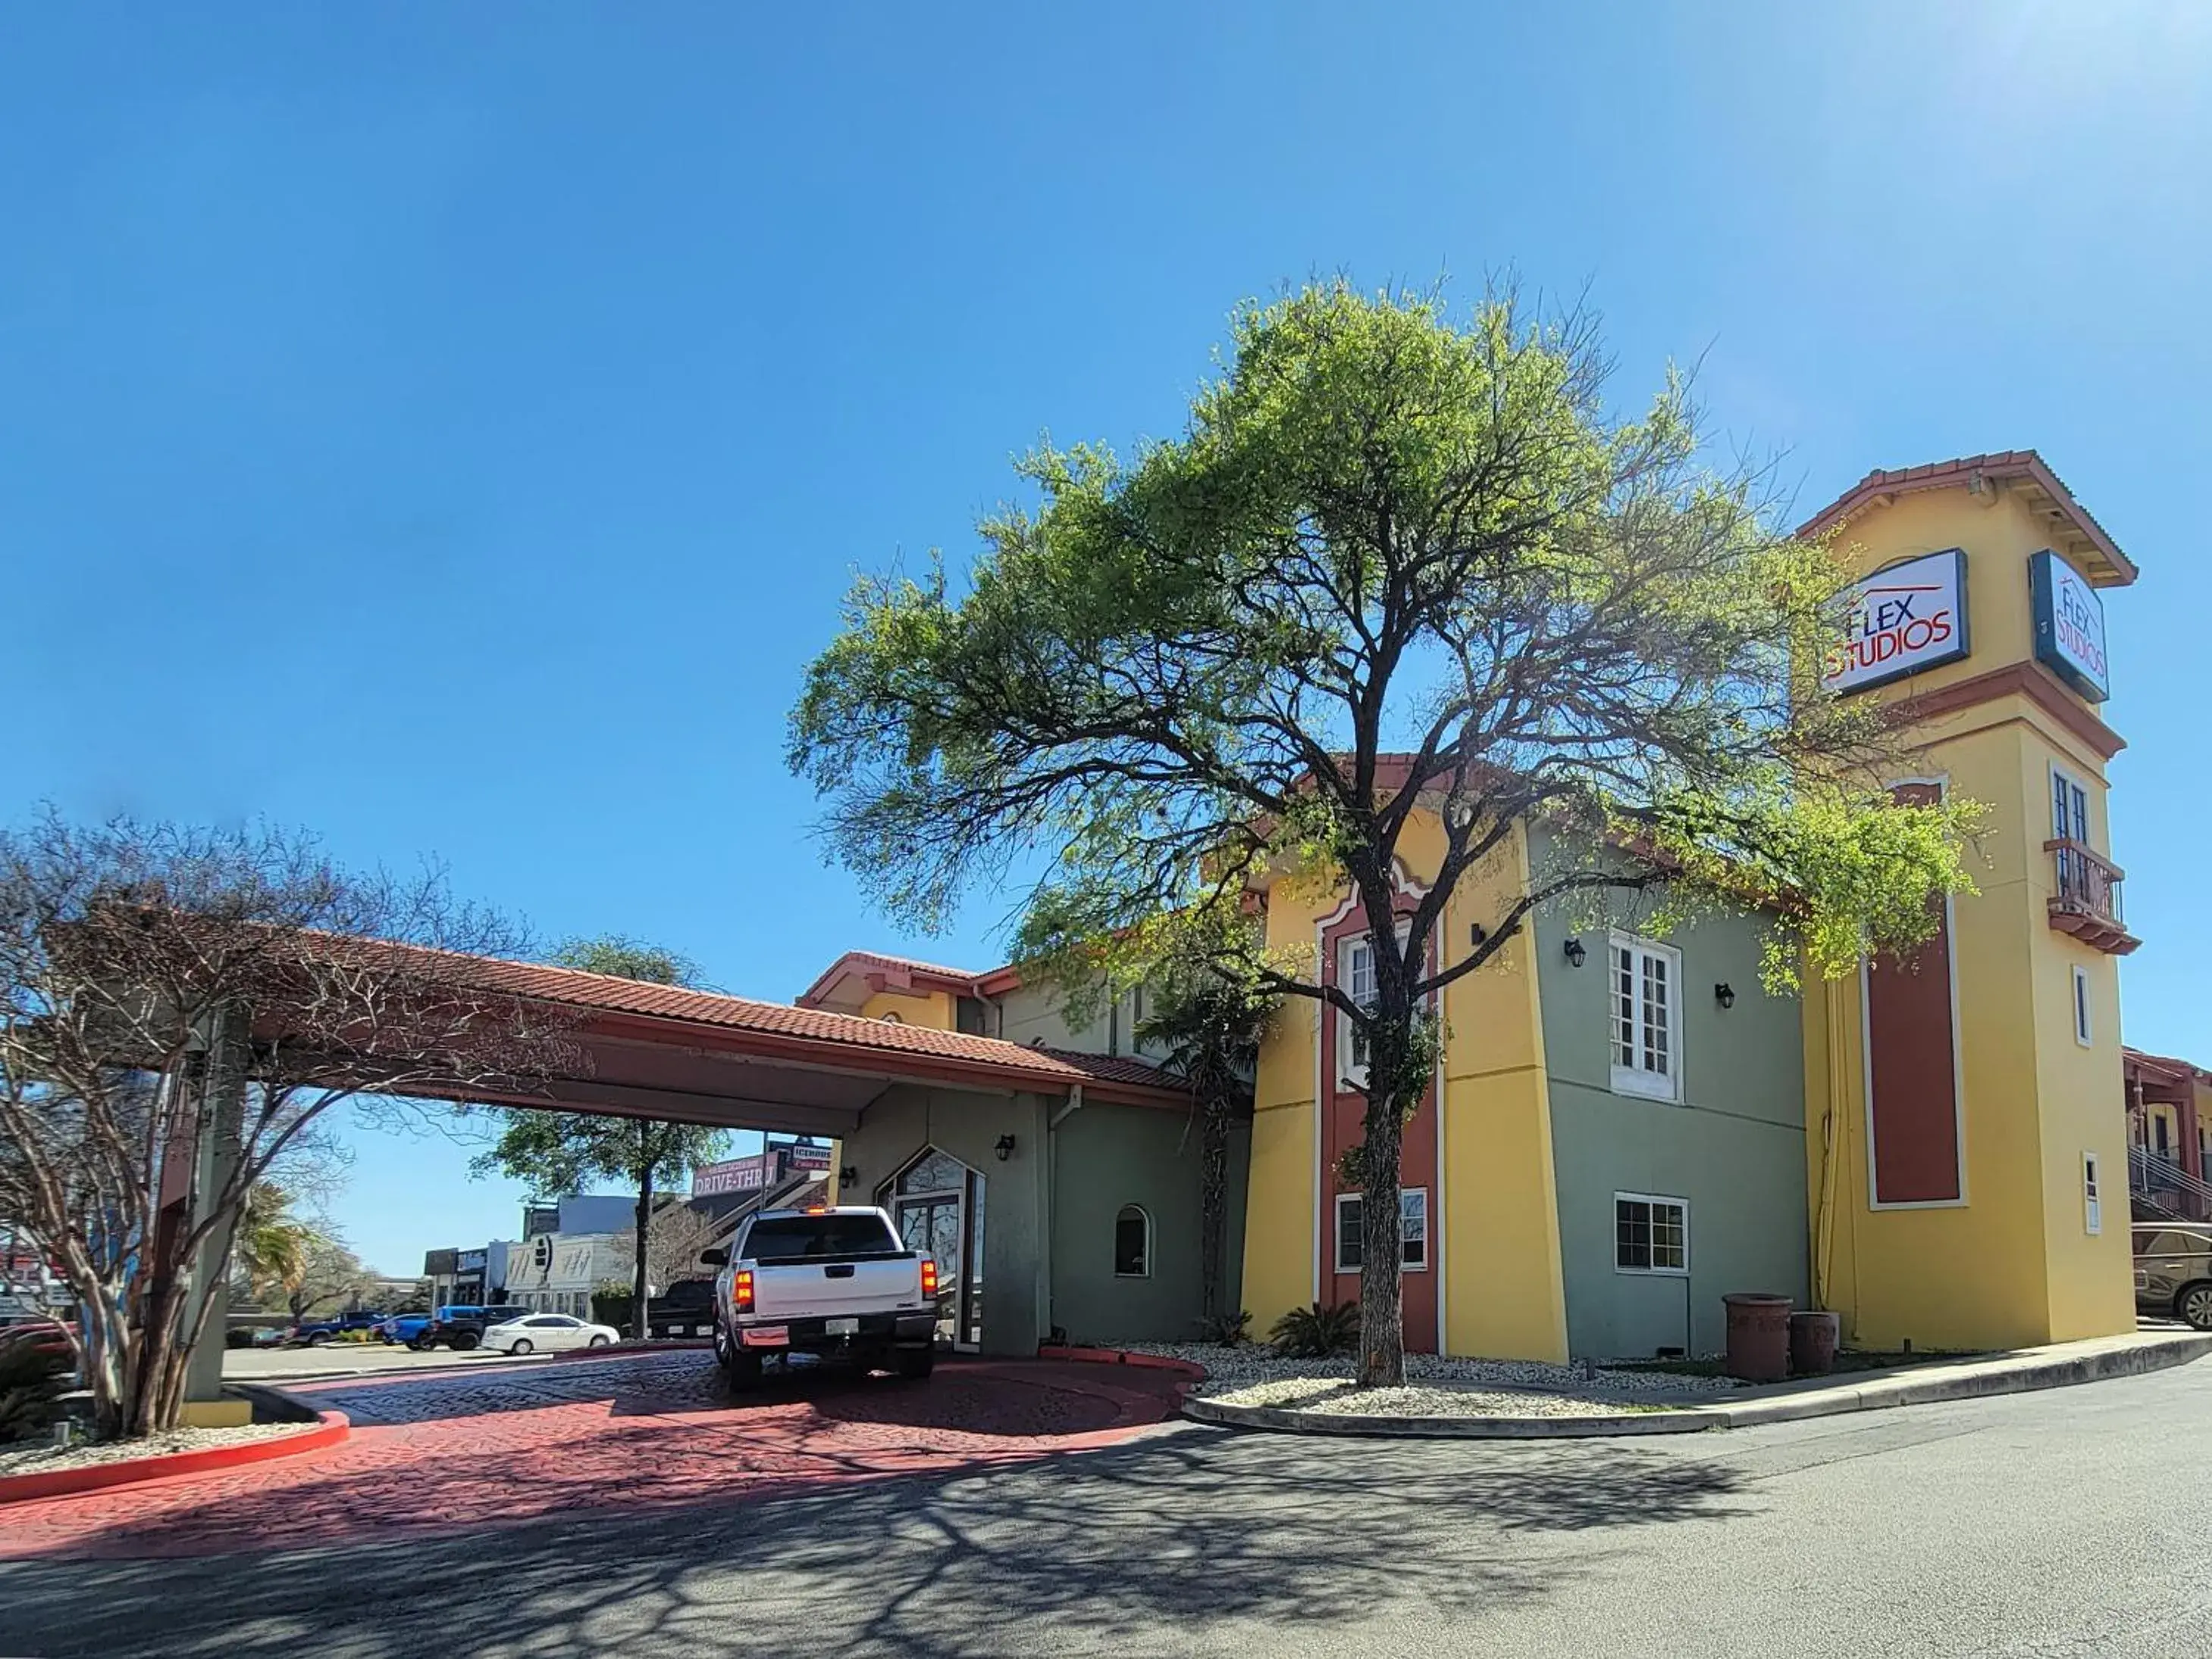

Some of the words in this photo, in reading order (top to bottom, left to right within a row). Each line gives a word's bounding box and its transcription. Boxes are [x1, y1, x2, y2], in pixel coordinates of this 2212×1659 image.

[1844, 593, 1916, 638] FLEX
[2062, 586, 2091, 640] FLEX
[1824, 609, 1952, 681] STUDIOS
[2056, 609, 2105, 678] STUDIOS
[795, 1147, 832, 1160] ICEHOUS
[695, 1166, 777, 1196] DRIVE-THRU
